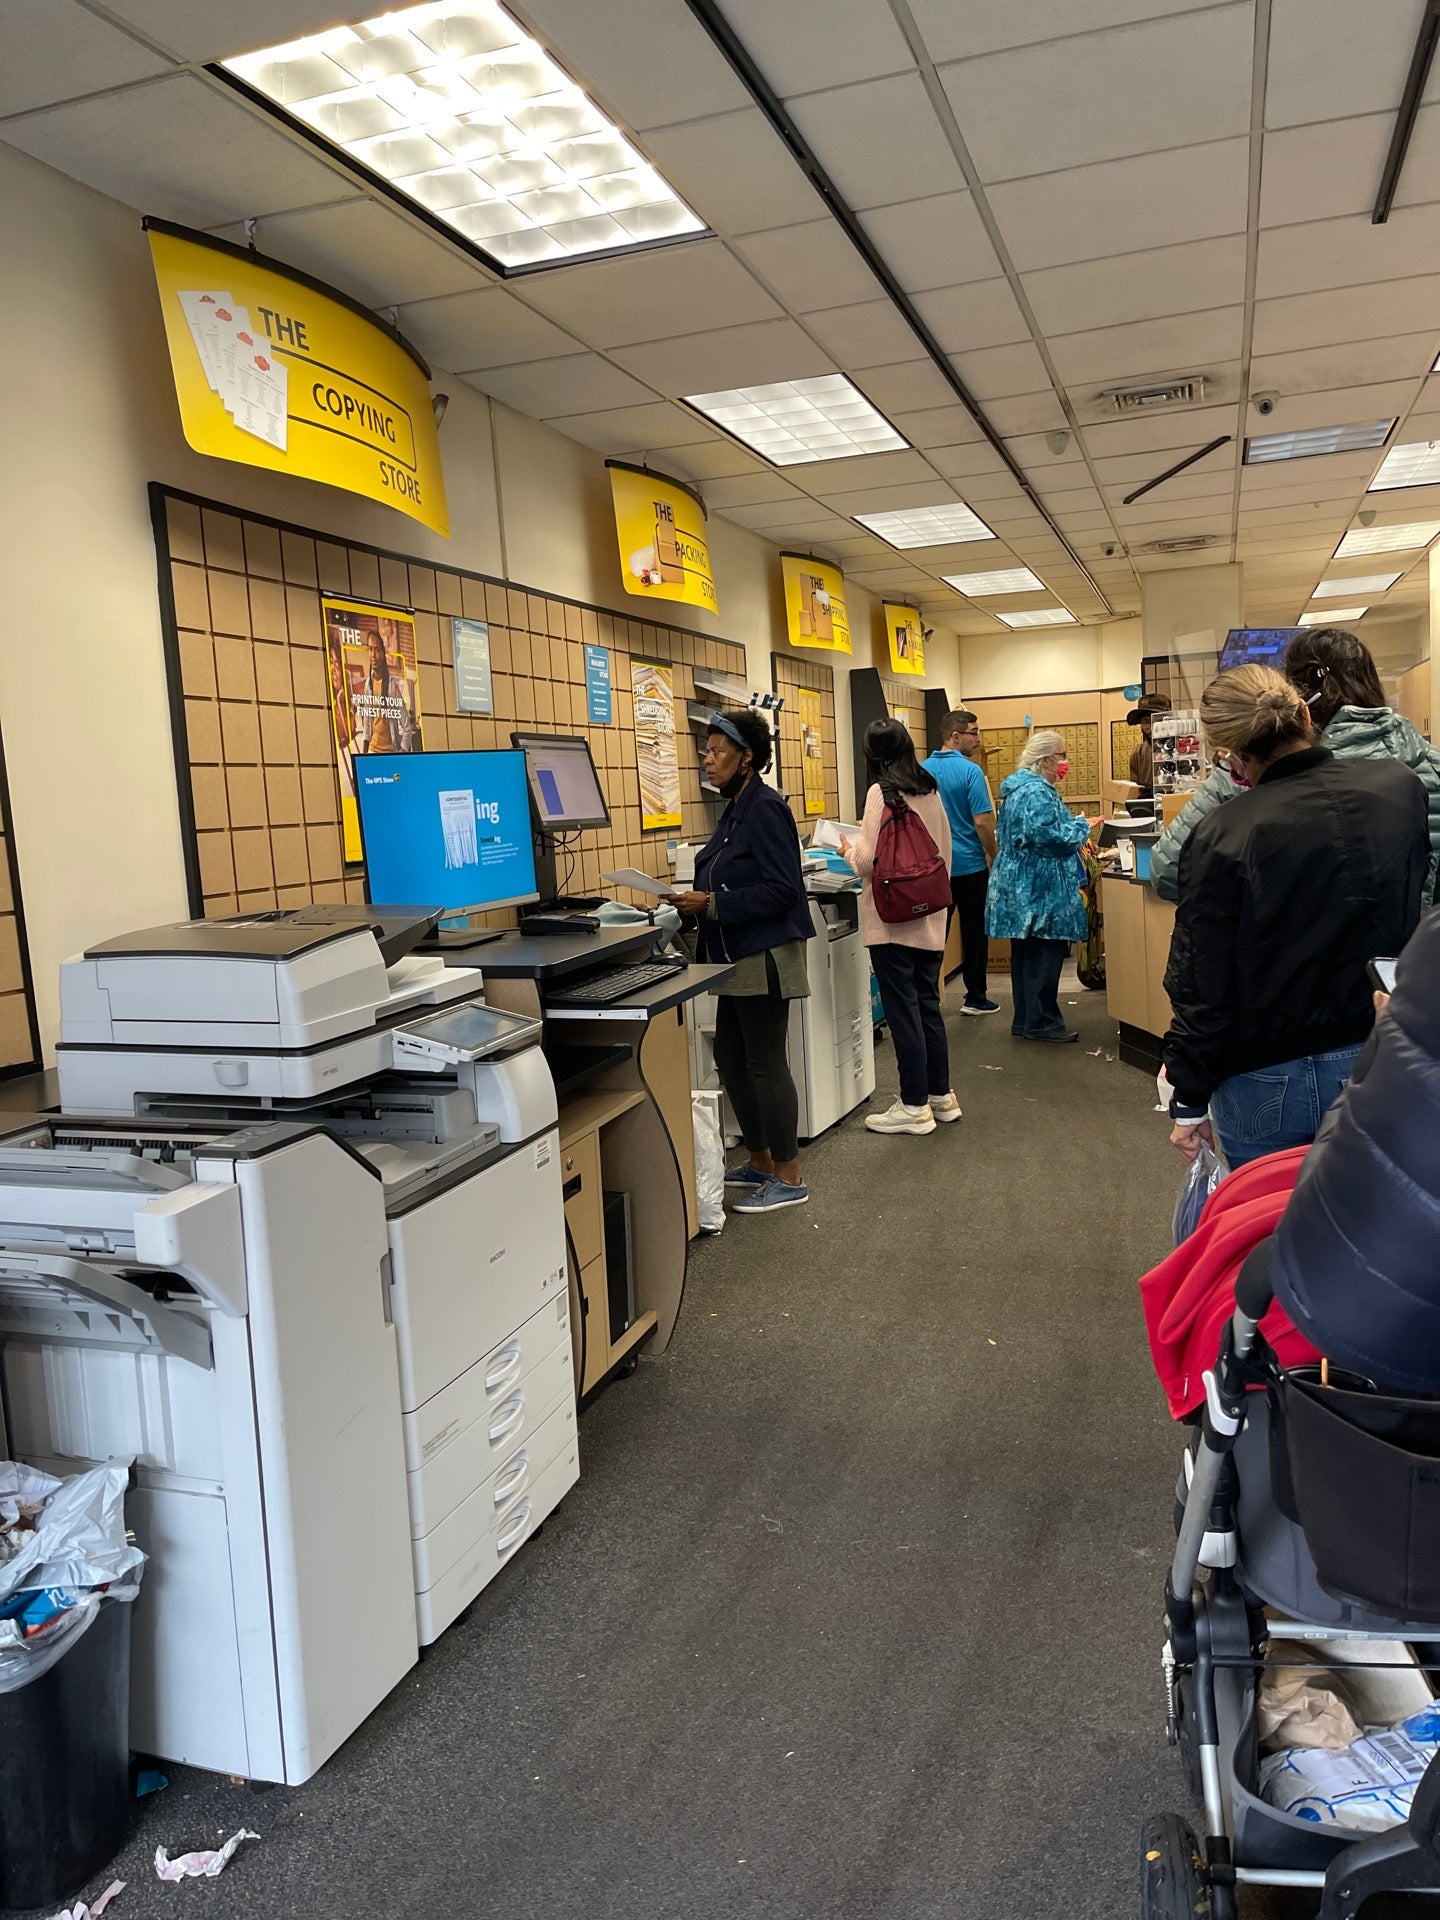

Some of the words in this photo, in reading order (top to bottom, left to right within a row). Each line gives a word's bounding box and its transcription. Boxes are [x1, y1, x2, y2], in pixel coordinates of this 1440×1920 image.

[257, 306, 310, 352] THE
[312, 382, 396, 443] COPYING
[379, 460, 422, 505] STORE
[653, 501, 673, 523] THE
[675, 541, 706, 568] PACKING
[810, 576, 824, 590] THE
[339, 627, 362, 646] THE
[352, 693, 385, 706] PRINTING
[385, 697, 403, 708] YOUR
[356, 706, 381, 718] FINEST
[381, 708, 402, 719] PIECES
[657, 722, 673, 734] STORE
[365, 777, 374, 785] The
[475, 798, 500, 825] ing
[489, 1247, 506, 1263] RICOH
